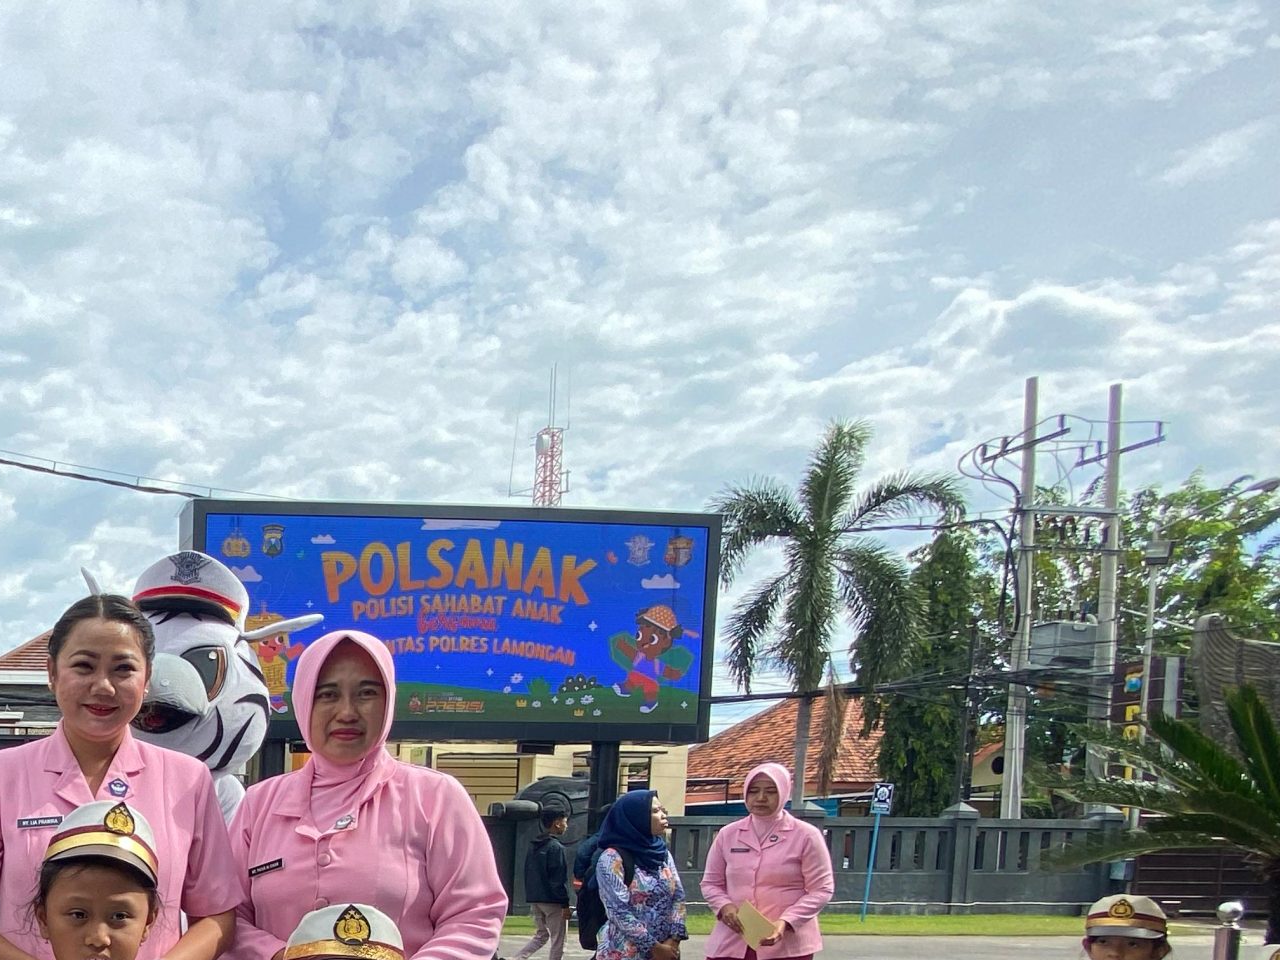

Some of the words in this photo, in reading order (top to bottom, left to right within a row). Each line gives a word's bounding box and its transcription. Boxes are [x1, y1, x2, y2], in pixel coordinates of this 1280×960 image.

[321, 538, 598, 605] POLSANAK
[352, 596, 414, 621] POLISI
[419, 594, 508, 616] SAHABAT
[511, 600, 565, 625] ANAK
[428, 636, 489, 654] POLRES
[491, 637, 577, 666] LAMONGAN
